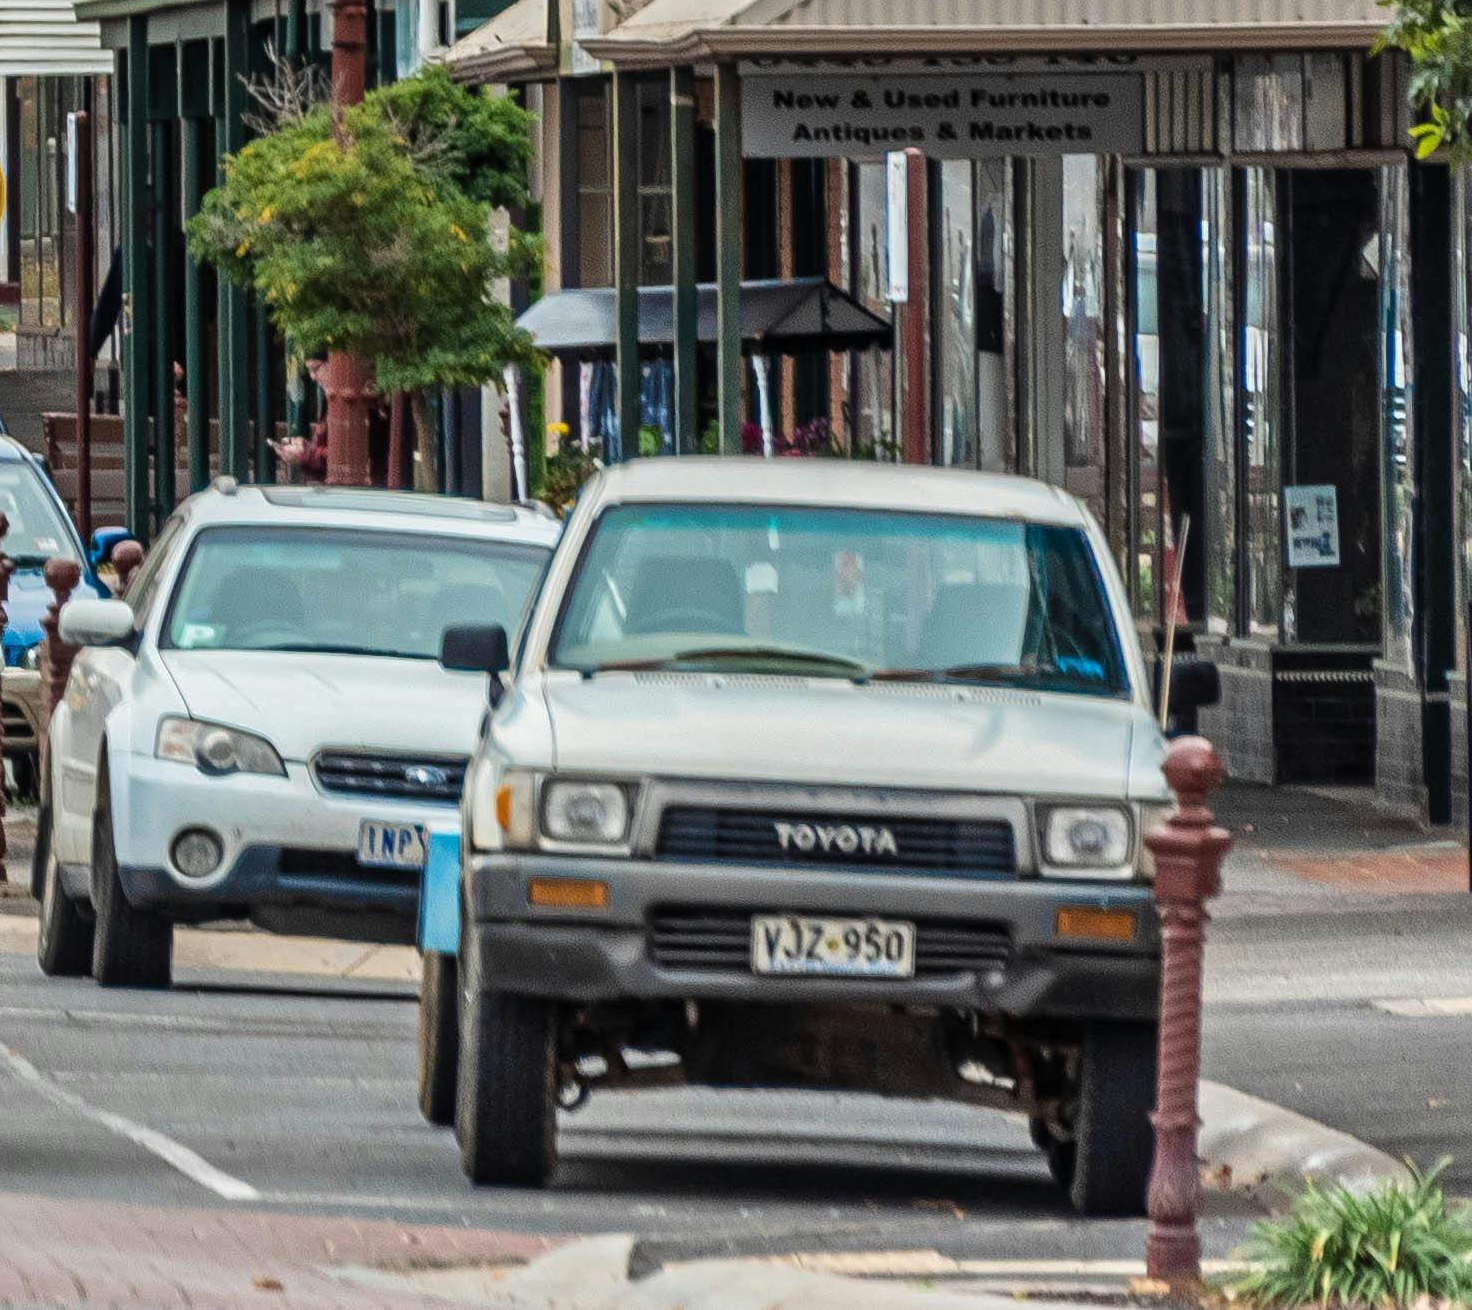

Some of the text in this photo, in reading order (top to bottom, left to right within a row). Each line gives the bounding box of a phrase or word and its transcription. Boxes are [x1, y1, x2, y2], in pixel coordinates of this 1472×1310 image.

[772, 88, 1111, 109] New & Used Furniture
[793, 121, 1094, 145] Antiques & Markets
[773, 821, 898, 856] TOYOTA
